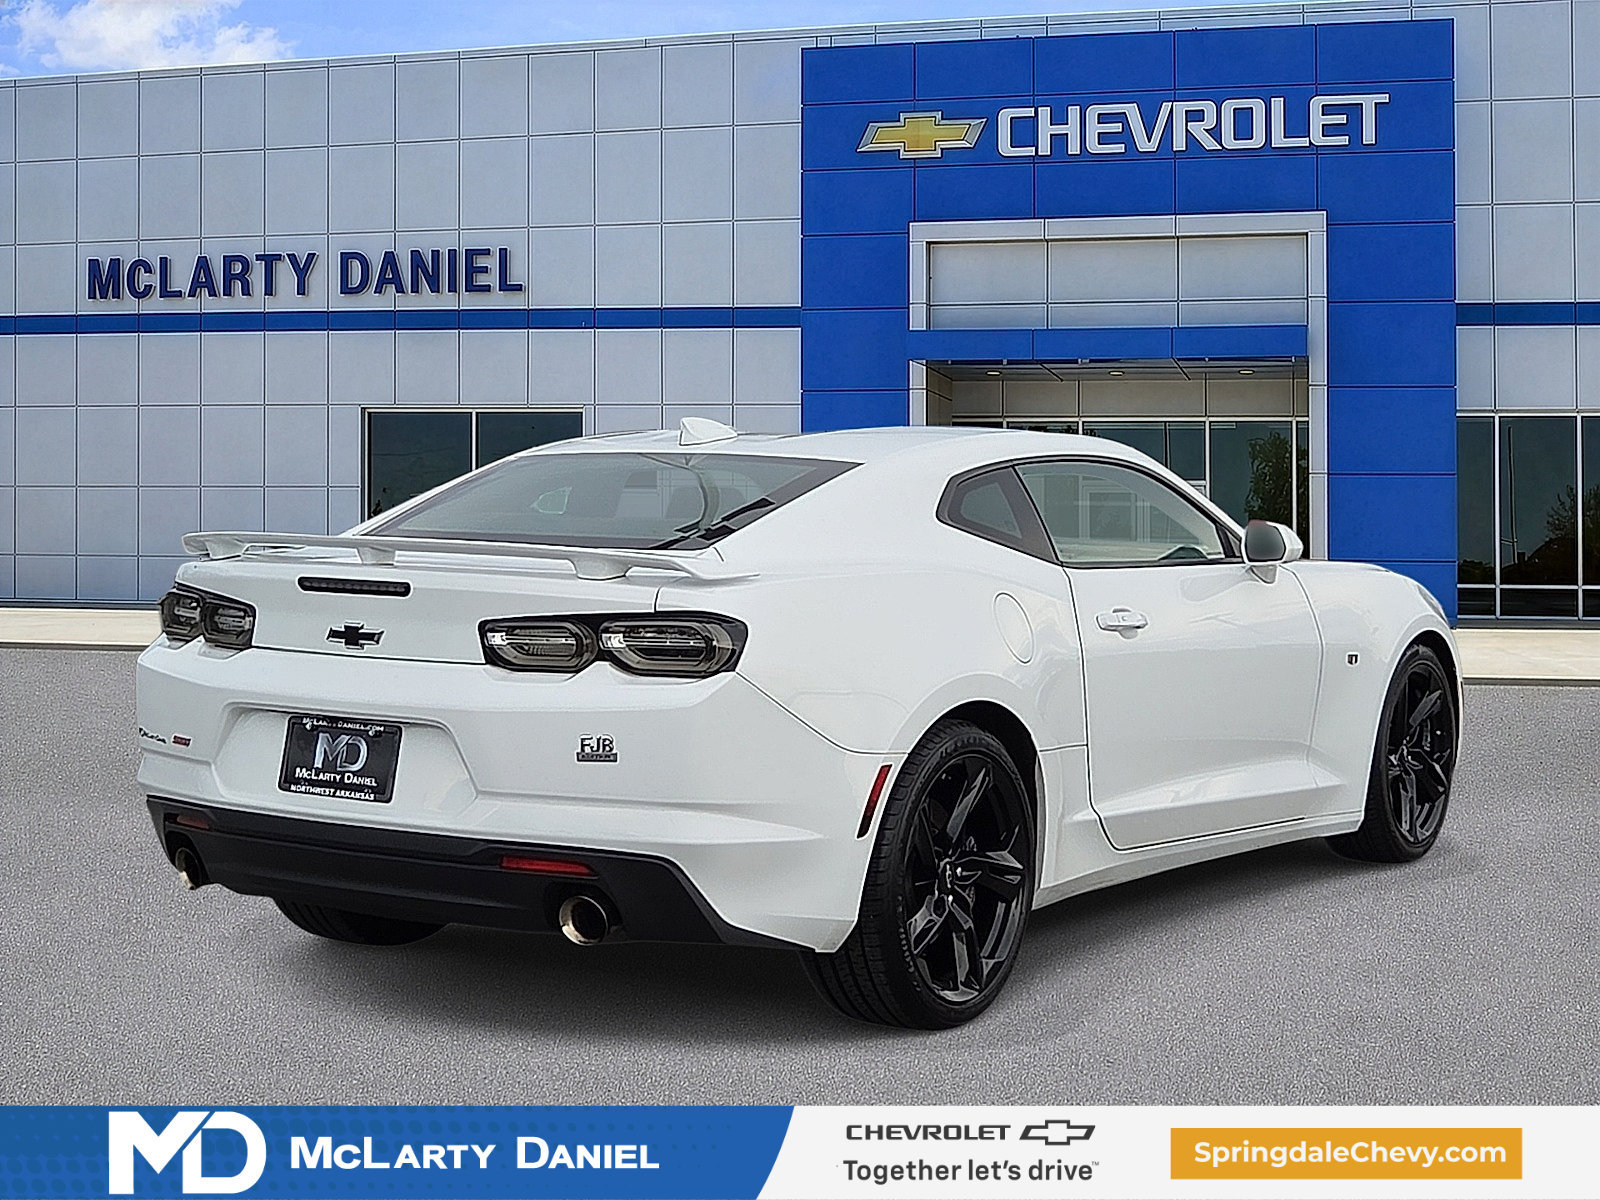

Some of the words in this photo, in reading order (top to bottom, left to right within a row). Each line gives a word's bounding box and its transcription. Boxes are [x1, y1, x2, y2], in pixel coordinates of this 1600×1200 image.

[997, 93, 1390, 158] CHEVROLET
[338, 246, 525, 296] DANIEL
[313, 732, 368, 772] MD
[579, 734, 614, 753] FJB
[290, 784, 336, 796] NORTHWEST
[335, 789, 375, 801] ARKANSAS
[344, 773, 378, 787] DANIEL
